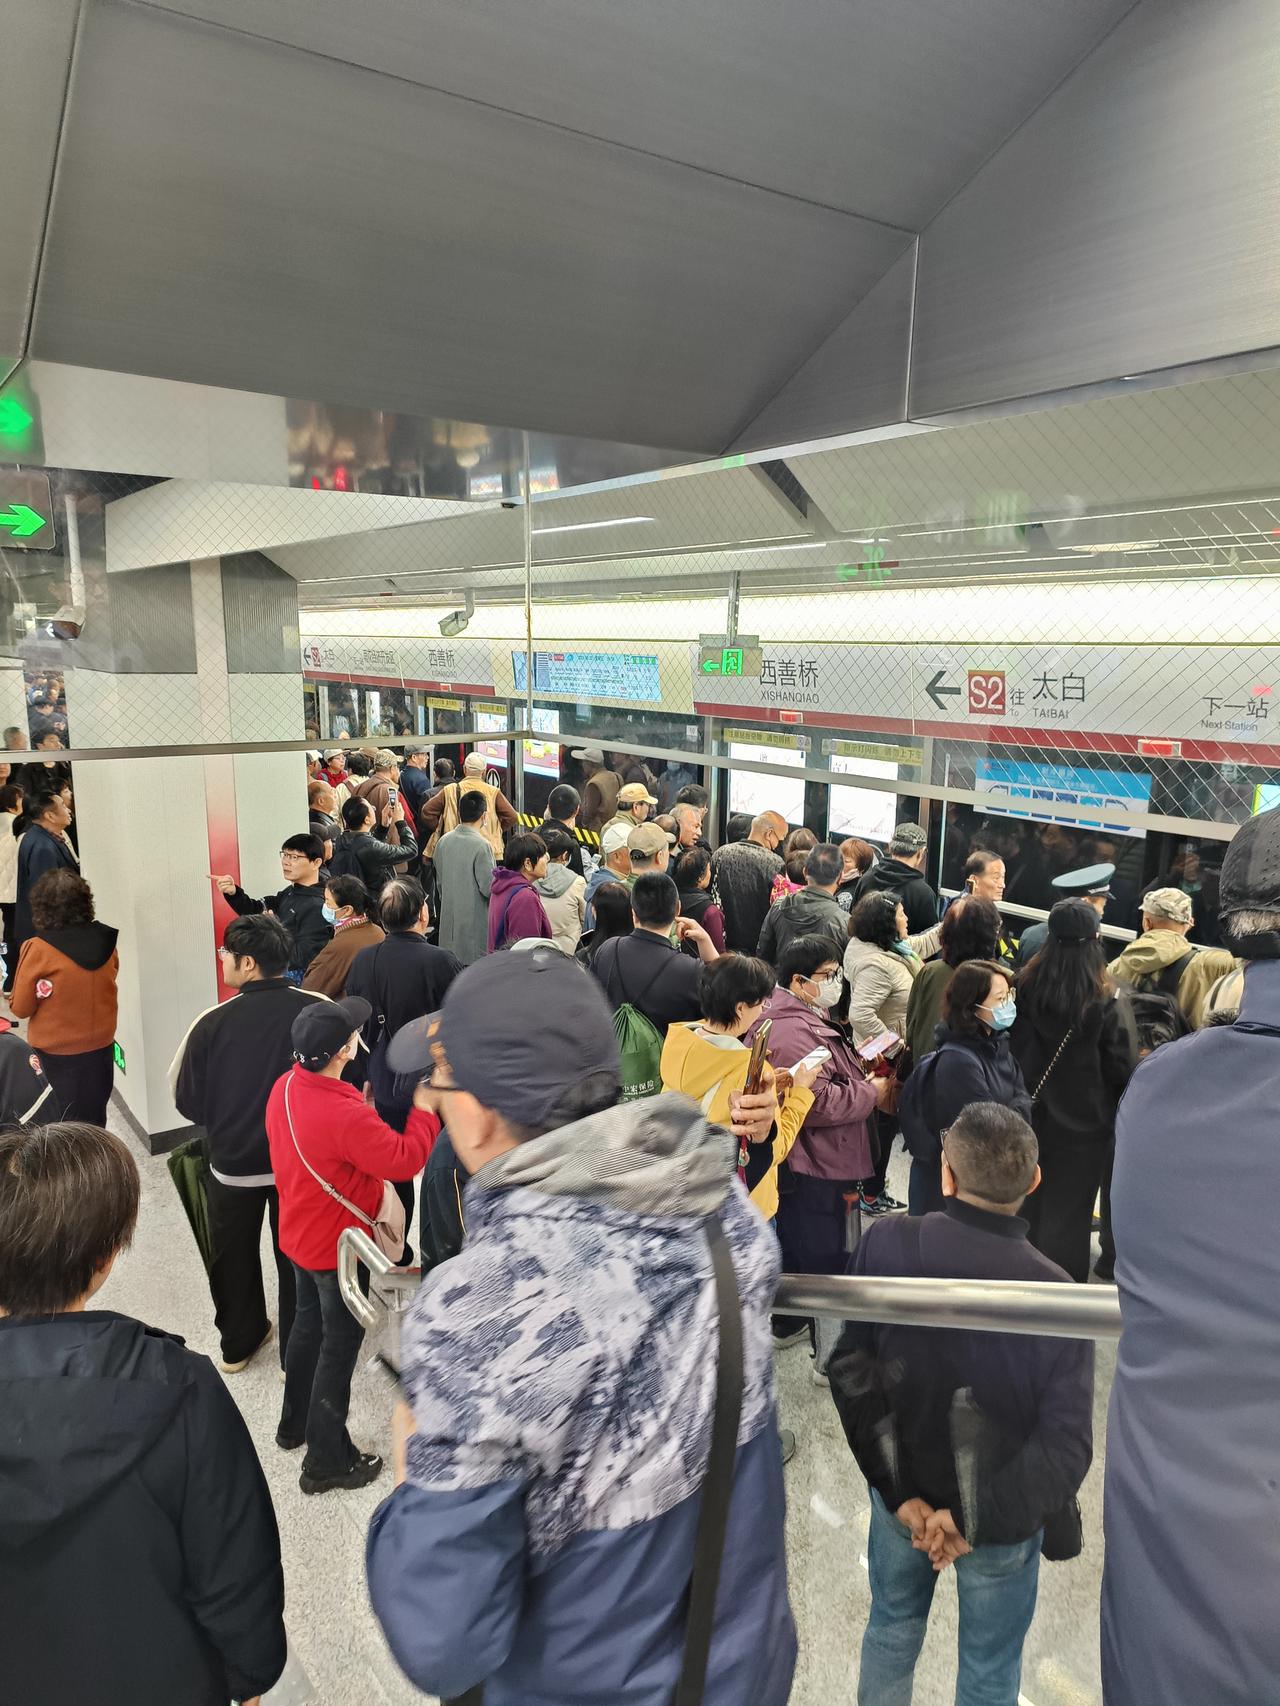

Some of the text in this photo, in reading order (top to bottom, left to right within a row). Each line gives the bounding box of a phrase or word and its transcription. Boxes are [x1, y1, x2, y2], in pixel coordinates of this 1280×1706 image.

[428, 649, 455, 668] 西善桥
[760, 659, 819, 688] 西善桥
[760, 690, 820, 704] XISHANQIAO
[970, 675, 1003, 709] S2
[1010, 671, 1086, 706] 往 太白
[1033, 708, 1069, 719] TAIBAI
[1202, 697, 1269, 719] 下一站
[1201, 719, 1258, 731] Next Station
